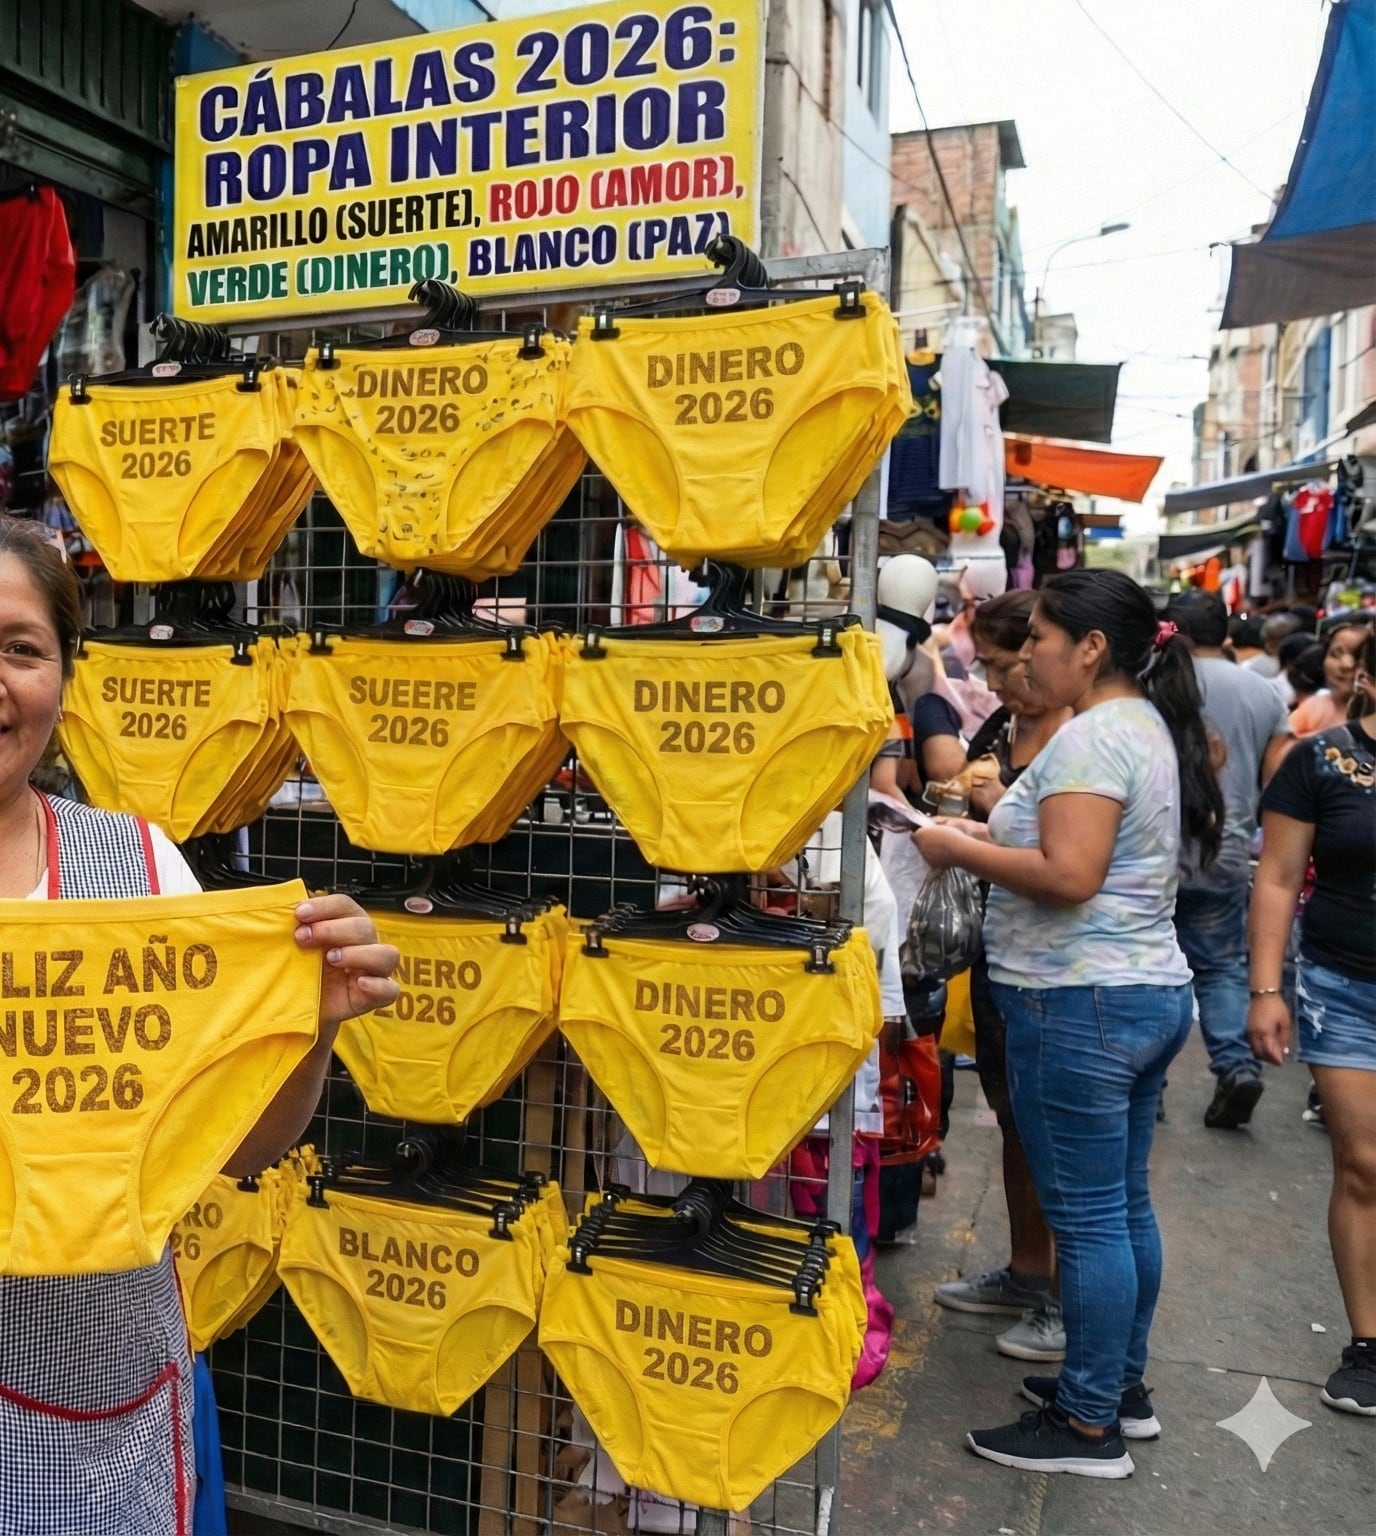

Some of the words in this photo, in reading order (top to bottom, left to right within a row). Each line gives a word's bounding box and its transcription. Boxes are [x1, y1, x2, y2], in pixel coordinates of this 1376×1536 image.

[200, 43, 495, 142] CÁBALAS
[517, 7, 736, 94] 2026:
[205, 132, 371, 207] ROPA
[391, 80, 726, 181] INTERIOR
[187, 207, 327, 258] AMARILLO
[336, 189, 481, 240] (SUERTE),
[490, 175, 579, 222] ROJO
[590, 156, 743, 210] (AMOR),
[187, 261, 288, 306] VERDE
[296, 243, 458, 295] (DINERO),
[468, 225, 616, 276] BLANCO
[357, 364, 488, 398] DINERO
[647, 342, 805, 388] DINERO
[376, 403, 460, 434] 2026
[675, 388, 774, 425] 2026
[100, 413, 216, 447] SUERTE
[121, 450, 192, 481] 2026
[101, 676, 211, 708] SUERTE
[349, 675, 476, 710] SUEERE
[634, 678, 785, 714] DINERO
[120, 712, 187, 741] 2026
[369, 714, 449, 748] 2026
[659, 721, 755, 754] 2026
[103, 935, 217, 994] AÑO
[634, 979, 786, 1023] DINERO
[659, 1024, 756, 1062] 2026
[11, 1063, 144, 1115] 2026
[339, 1228, 480, 1278] BLANCO
[366, 1270, 446, 1310] 2026
[615, 1299, 773, 1359] DINERO
[643, 1347, 739, 1395] 2026
